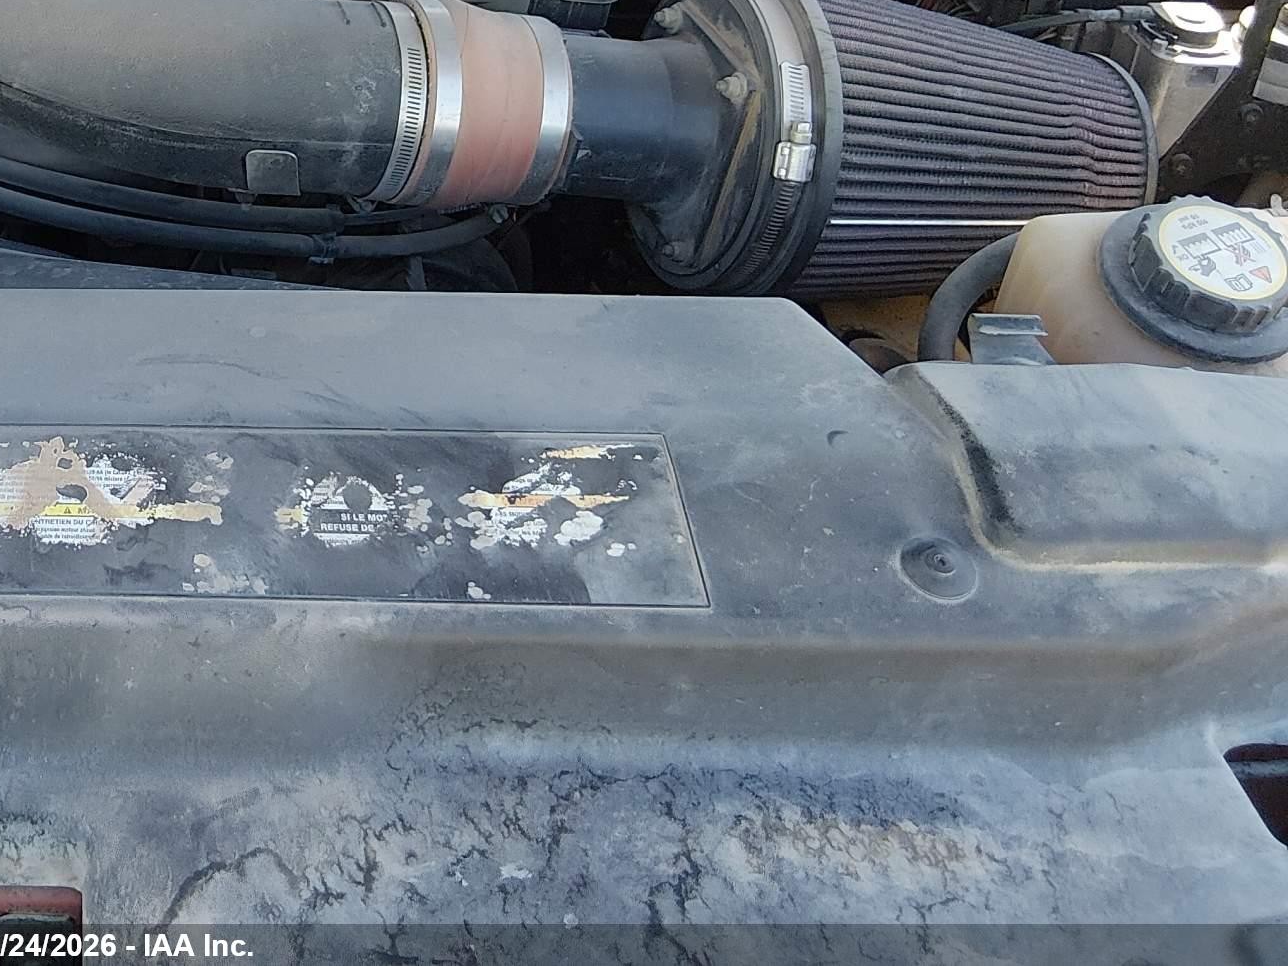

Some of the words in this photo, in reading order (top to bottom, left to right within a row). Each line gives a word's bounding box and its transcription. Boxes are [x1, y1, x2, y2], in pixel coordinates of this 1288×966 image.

[340, 512, 351, 521] SI
[352, 513, 365, 522] LE
[320, 523, 359, 532] REFUSE
[361, 523, 375, 532] DE
